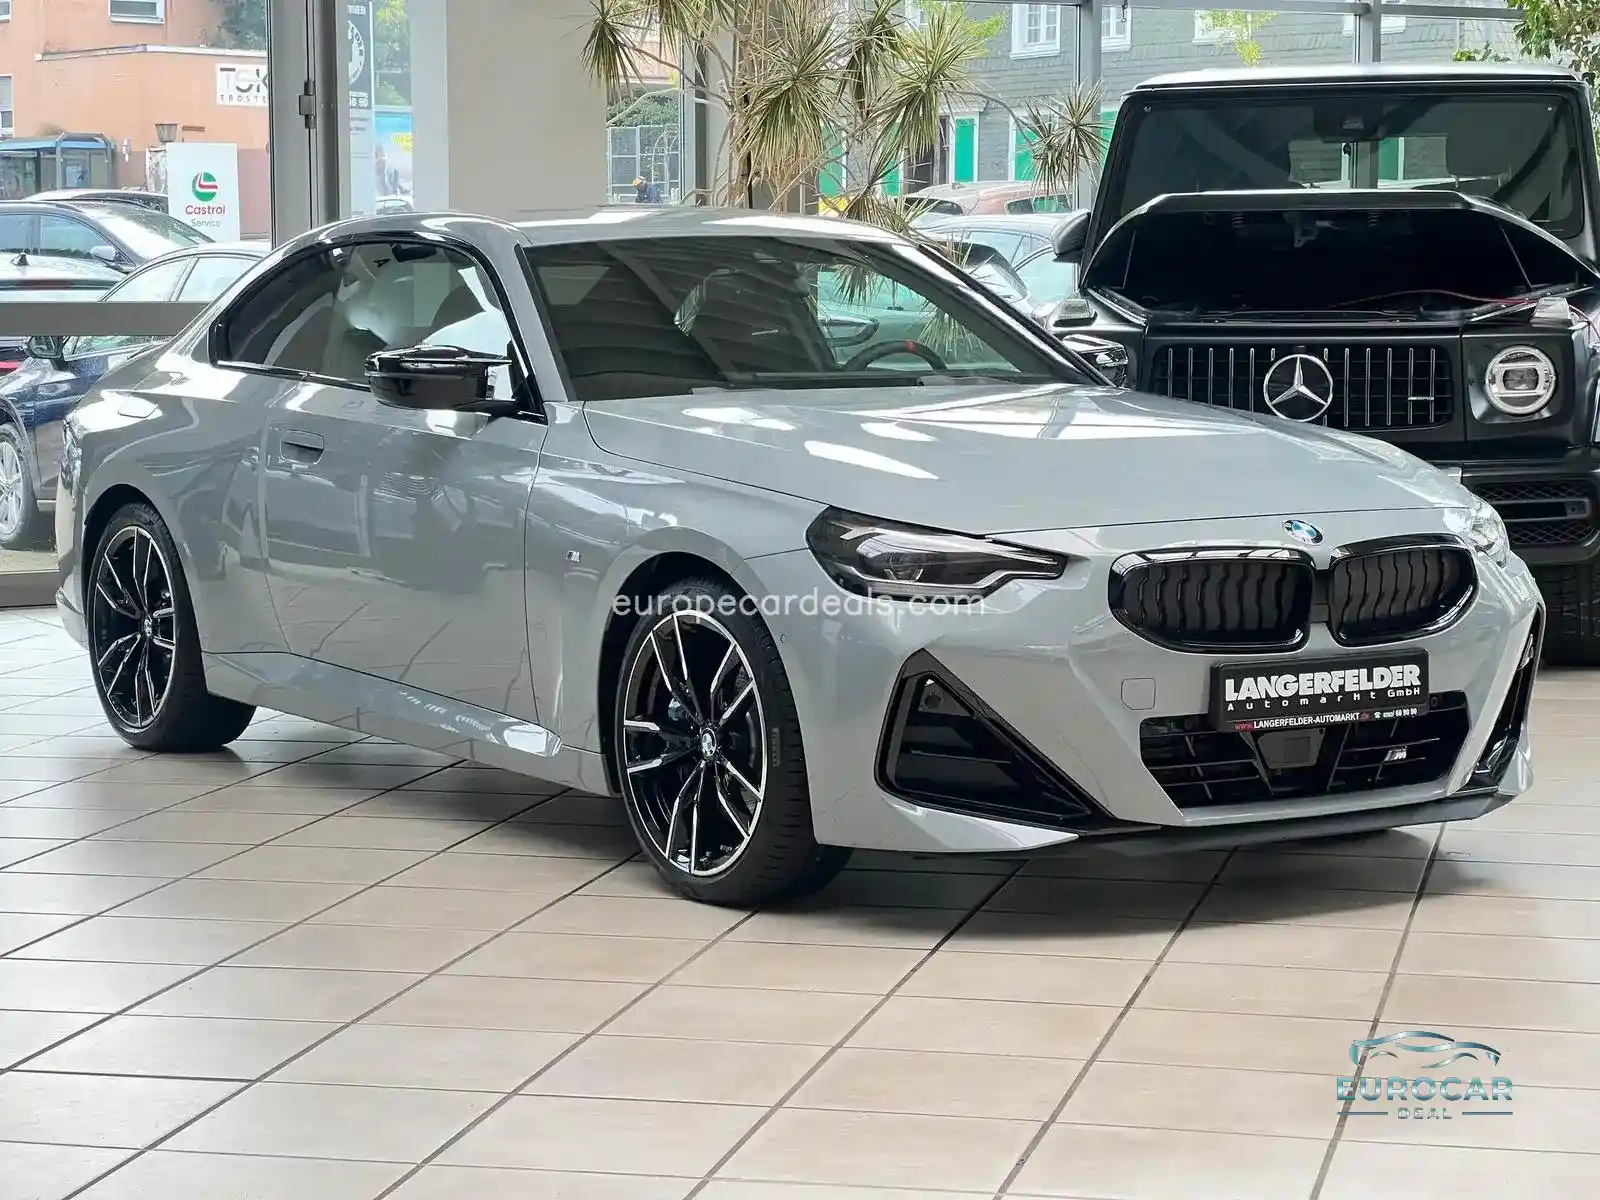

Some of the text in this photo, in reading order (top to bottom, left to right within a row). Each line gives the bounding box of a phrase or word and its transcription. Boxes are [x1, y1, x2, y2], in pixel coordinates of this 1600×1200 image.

[185, 204, 226, 215] Castrol
[191, 219, 221, 227] Service
[1225, 664, 1422, 702] LANGERFELDER
[1387, 687, 1421, 698] GmbH
